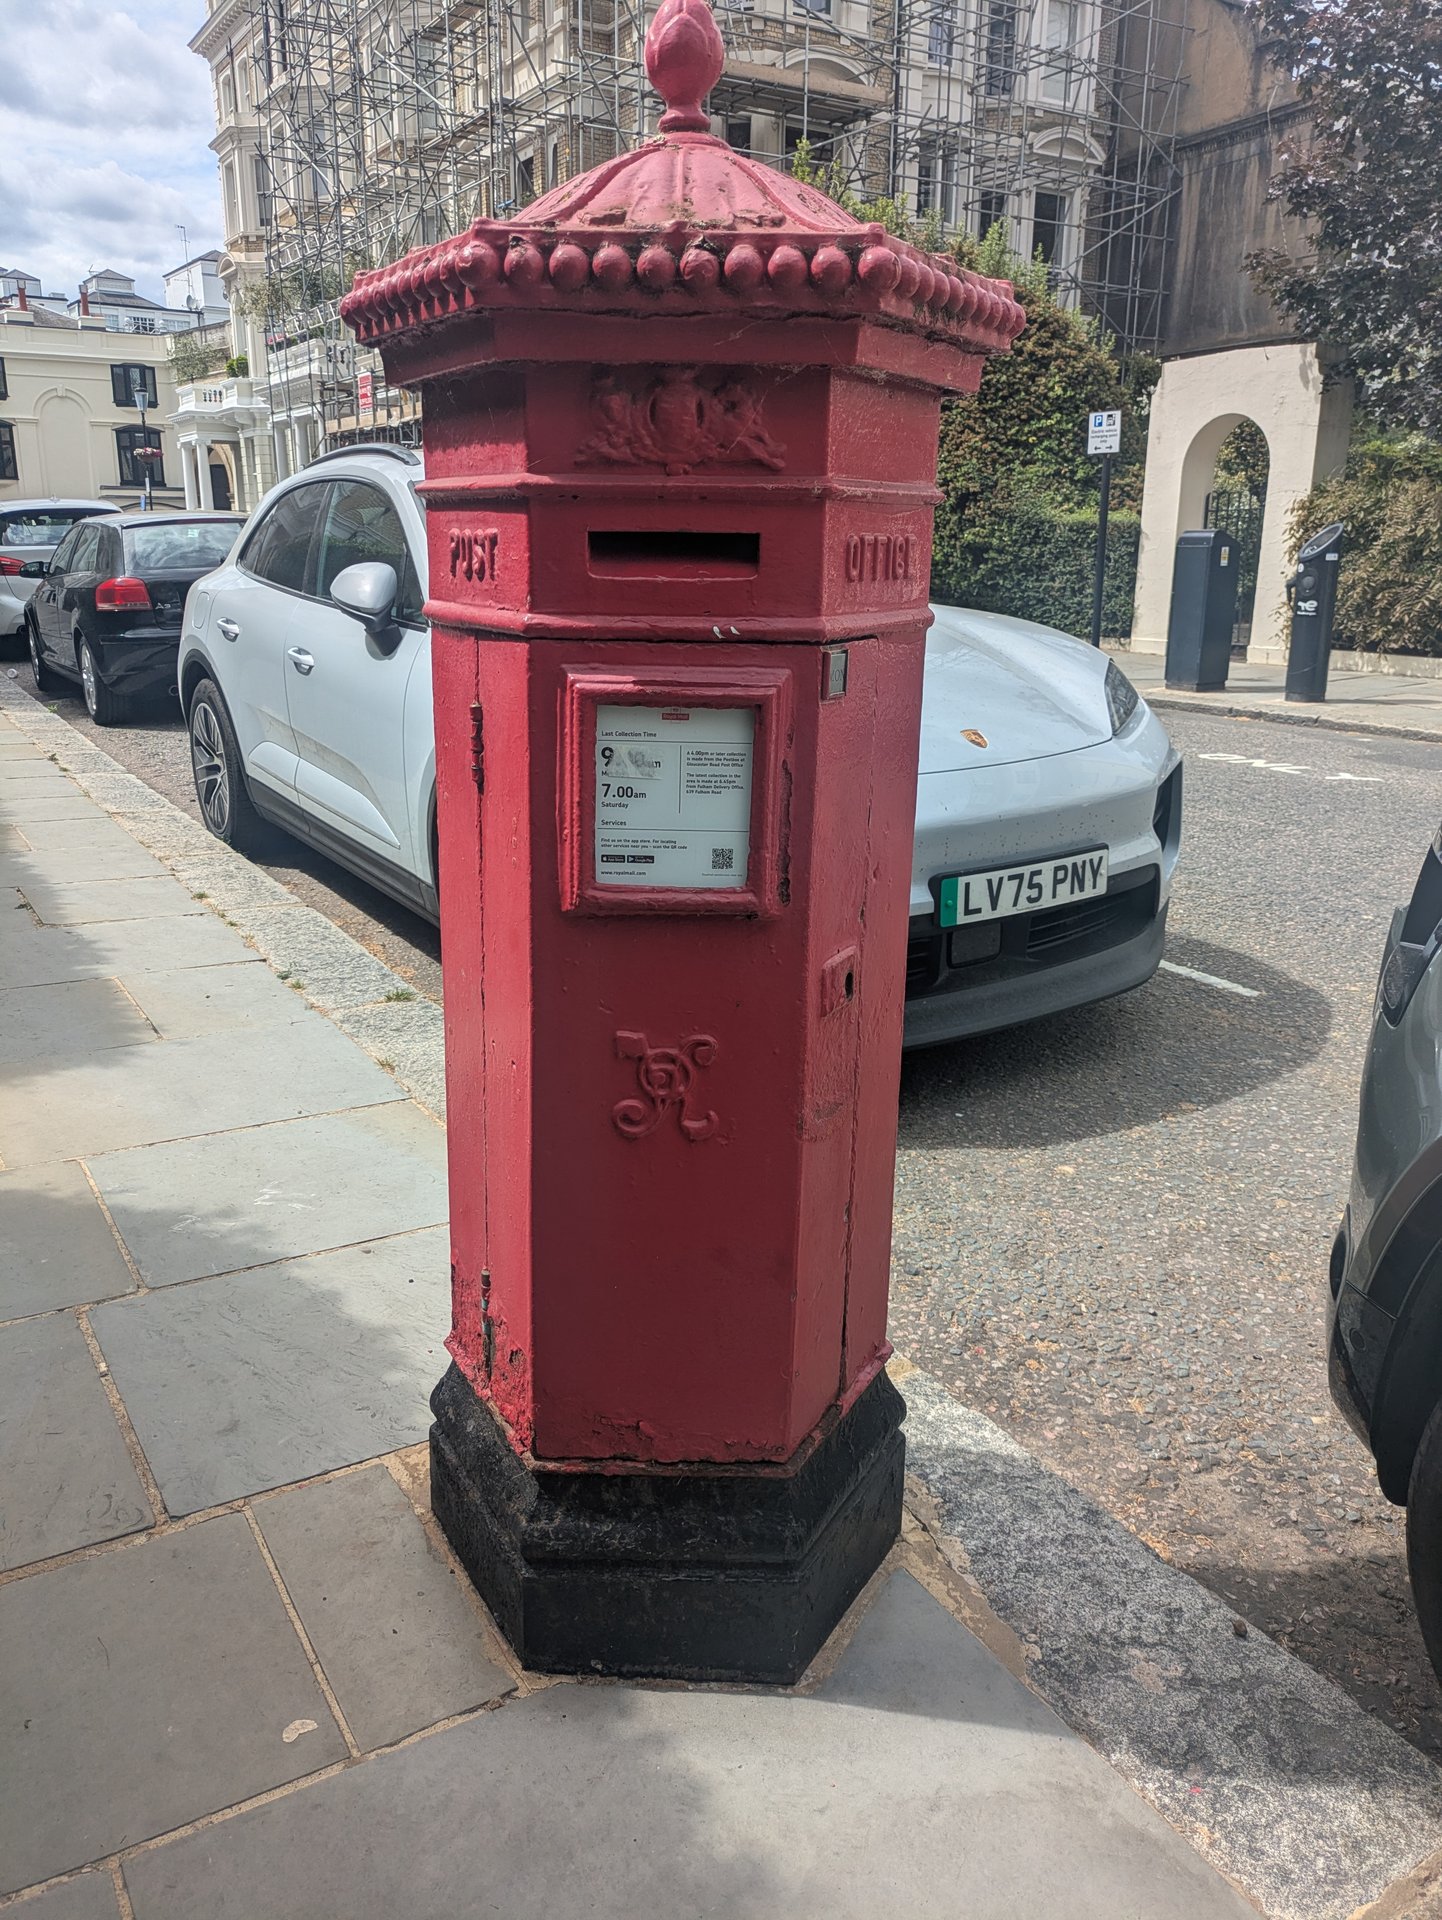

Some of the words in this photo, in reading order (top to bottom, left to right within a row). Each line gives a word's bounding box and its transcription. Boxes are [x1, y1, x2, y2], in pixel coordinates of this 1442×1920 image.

[449, 527, 499, 583] POST
[845, 533, 917, 583] OFFICE
[601, 783, 647, 799] 7.00am
[601, 801, 629, 809] Saturday
[963, 868, 1044, 917] LV75
[1052, 855, 1104, 900] PNY
